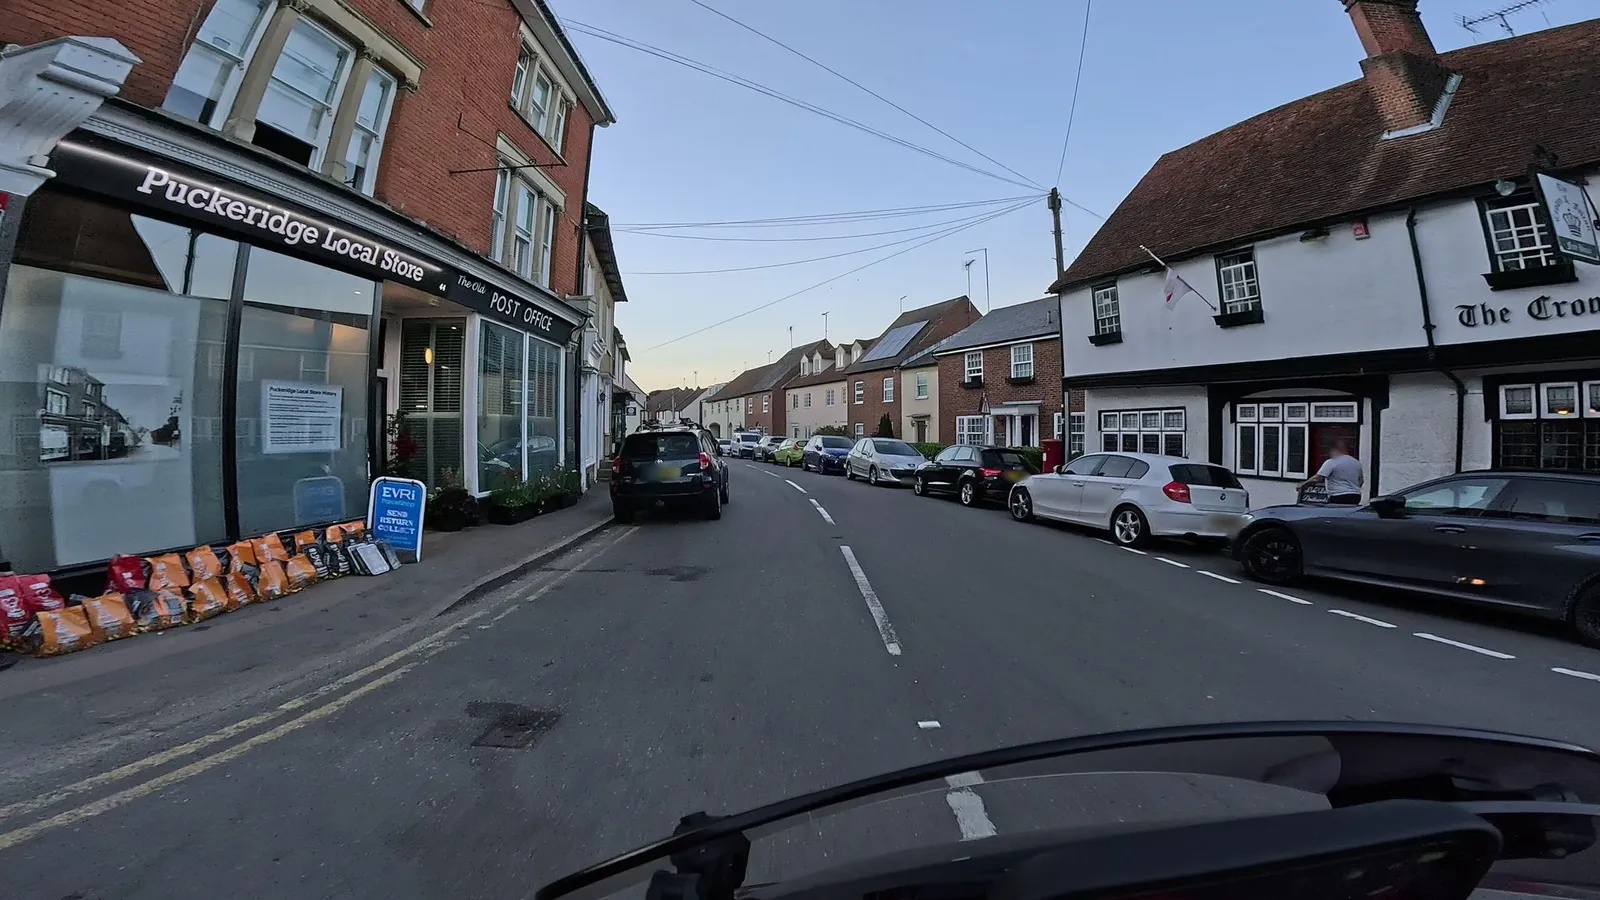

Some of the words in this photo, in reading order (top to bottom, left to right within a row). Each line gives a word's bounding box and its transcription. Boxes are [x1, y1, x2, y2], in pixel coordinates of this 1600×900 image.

[136, 165, 319, 245] Puckeridge
[321, 227, 380, 266] Local
[380, 250, 424, 282] Store
[457, 274, 472, 289] The
[471, 281, 487, 295] Old
[490, 291, 521, 318] POST
[523, 307, 553, 332] OFFICE
[1455, 301, 1512, 328] The
[379, 516, 414, 527] RETURN
[386, 509, 408, 518] SEND
[377, 524, 416, 535] COLLECT
